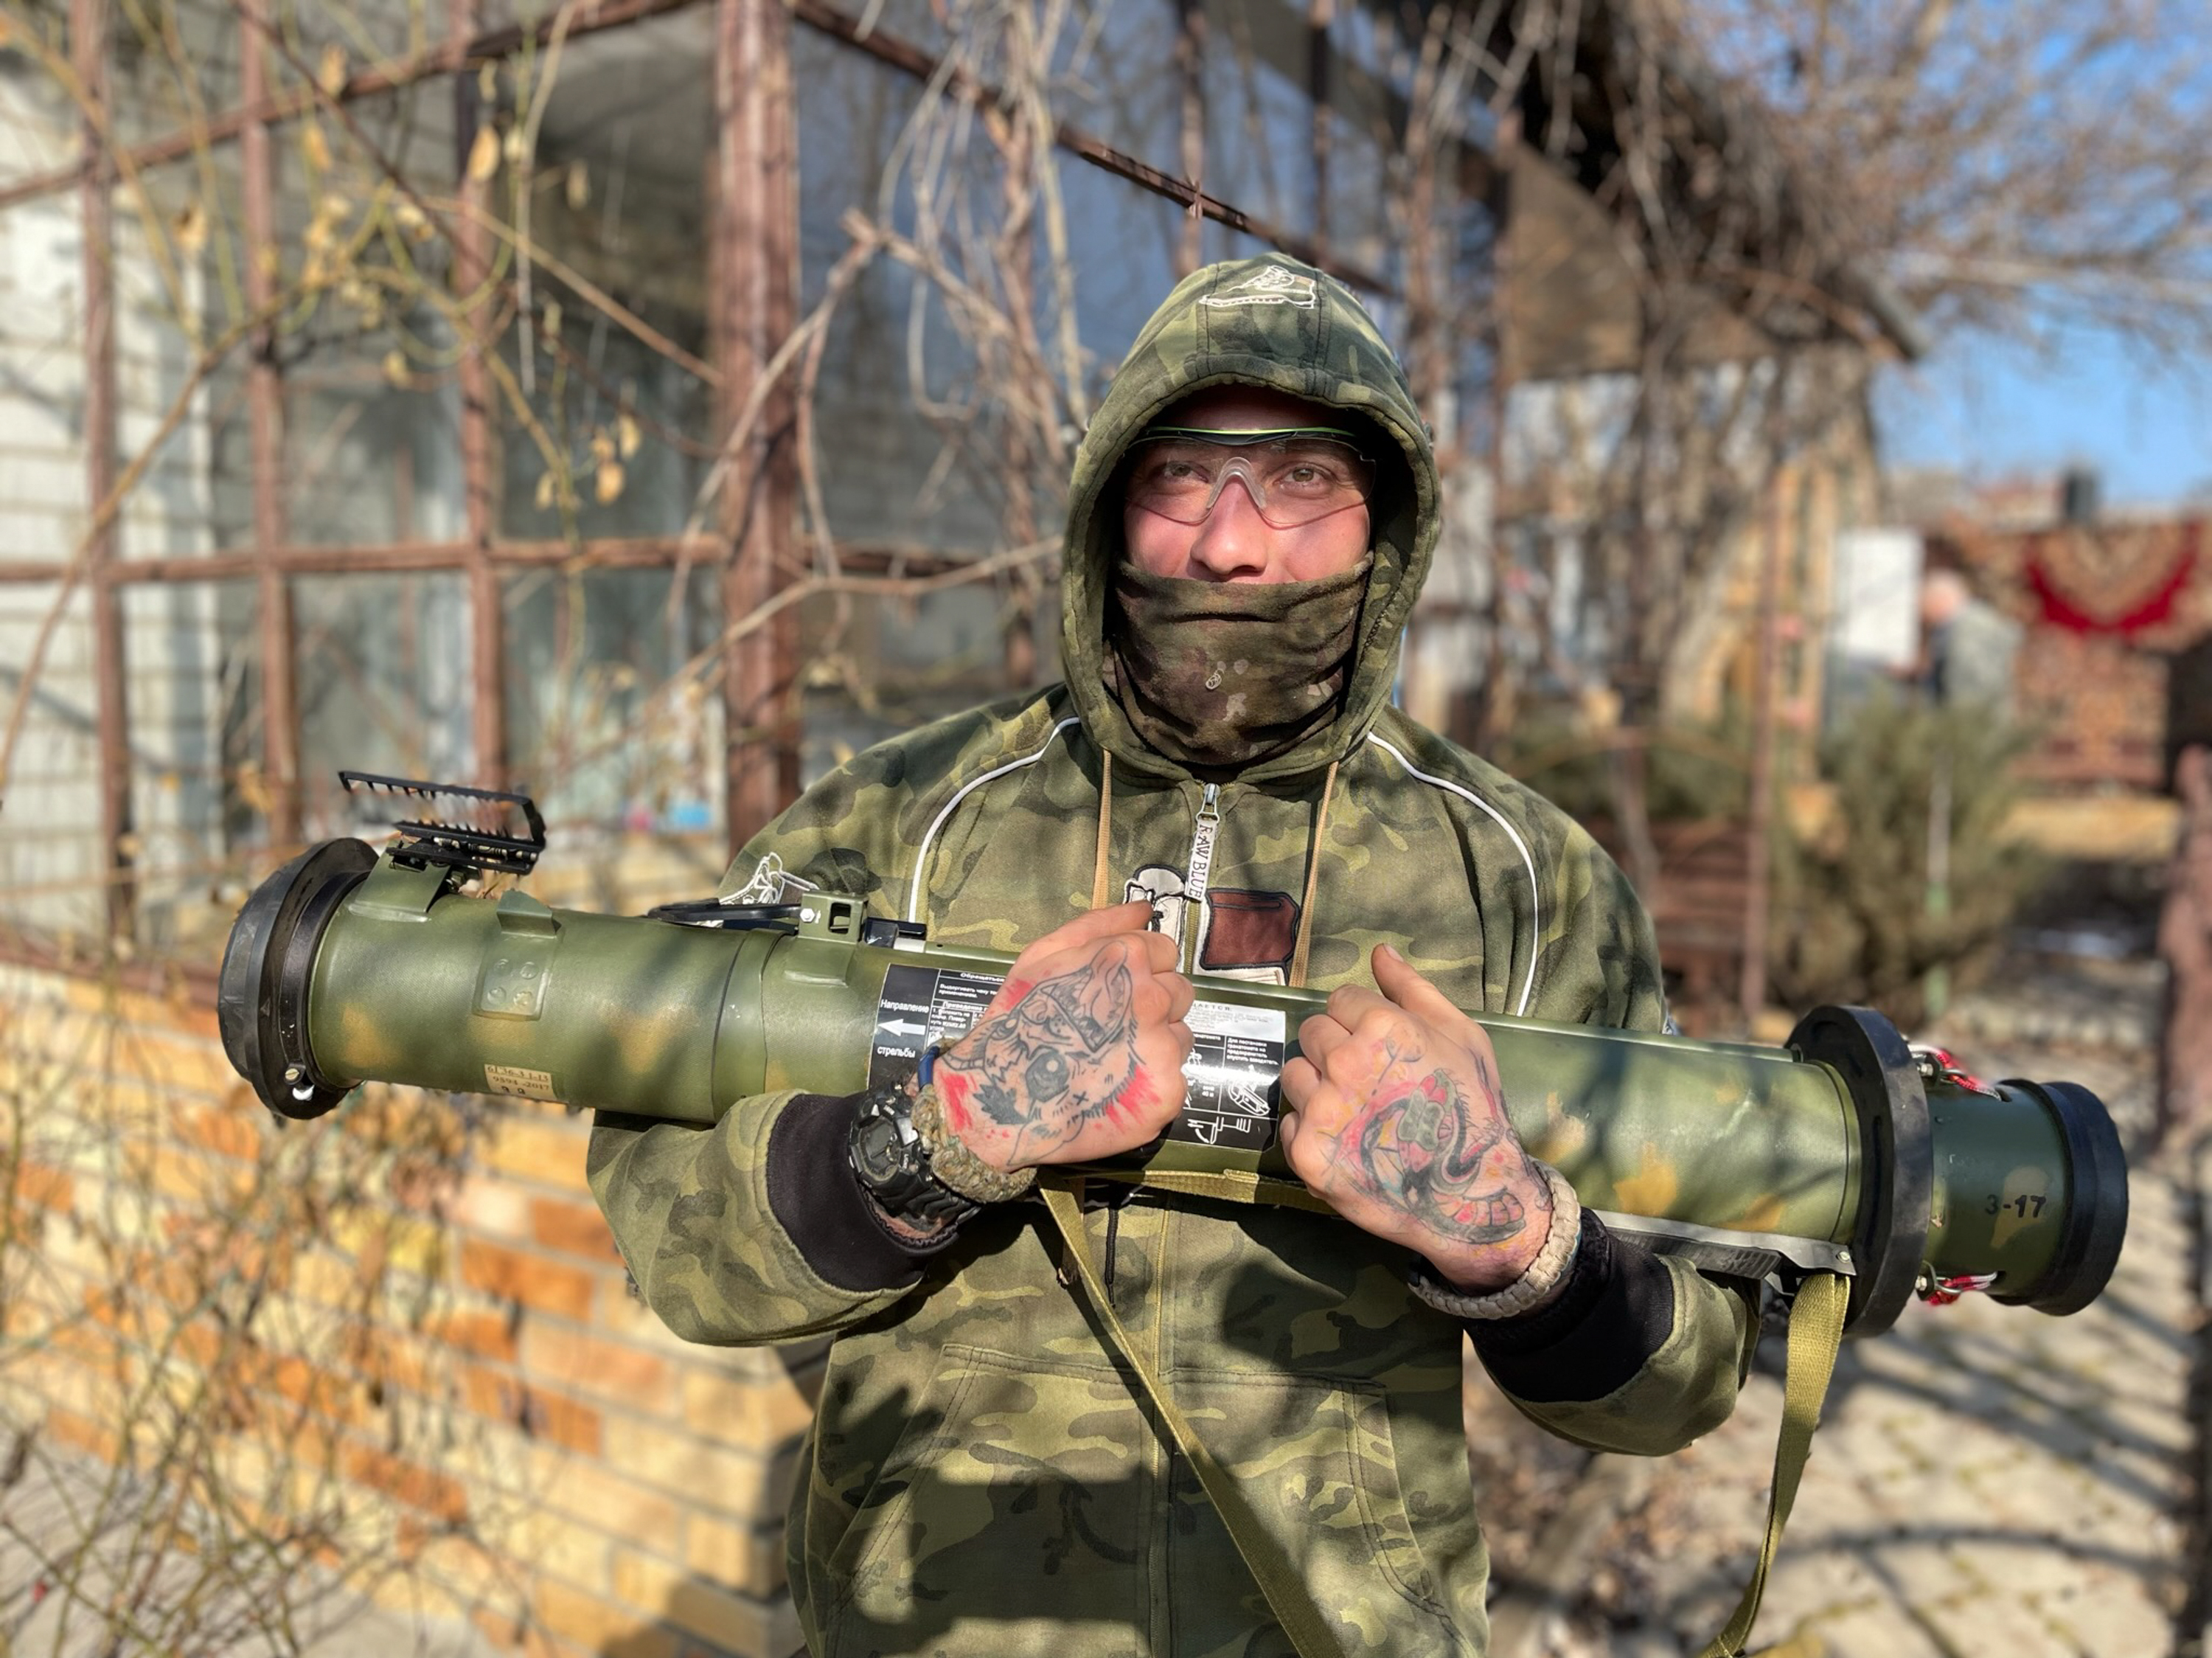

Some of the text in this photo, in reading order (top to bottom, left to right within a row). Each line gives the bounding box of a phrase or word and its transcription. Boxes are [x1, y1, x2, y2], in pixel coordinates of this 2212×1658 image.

[1189, 824, 1214, 898] RAW BLUE
[880, 999, 930, 1013] Направление
[877, 1045, 916, 1058] стрельбы
[1984, 1193, 2047, 1218] 3-17
